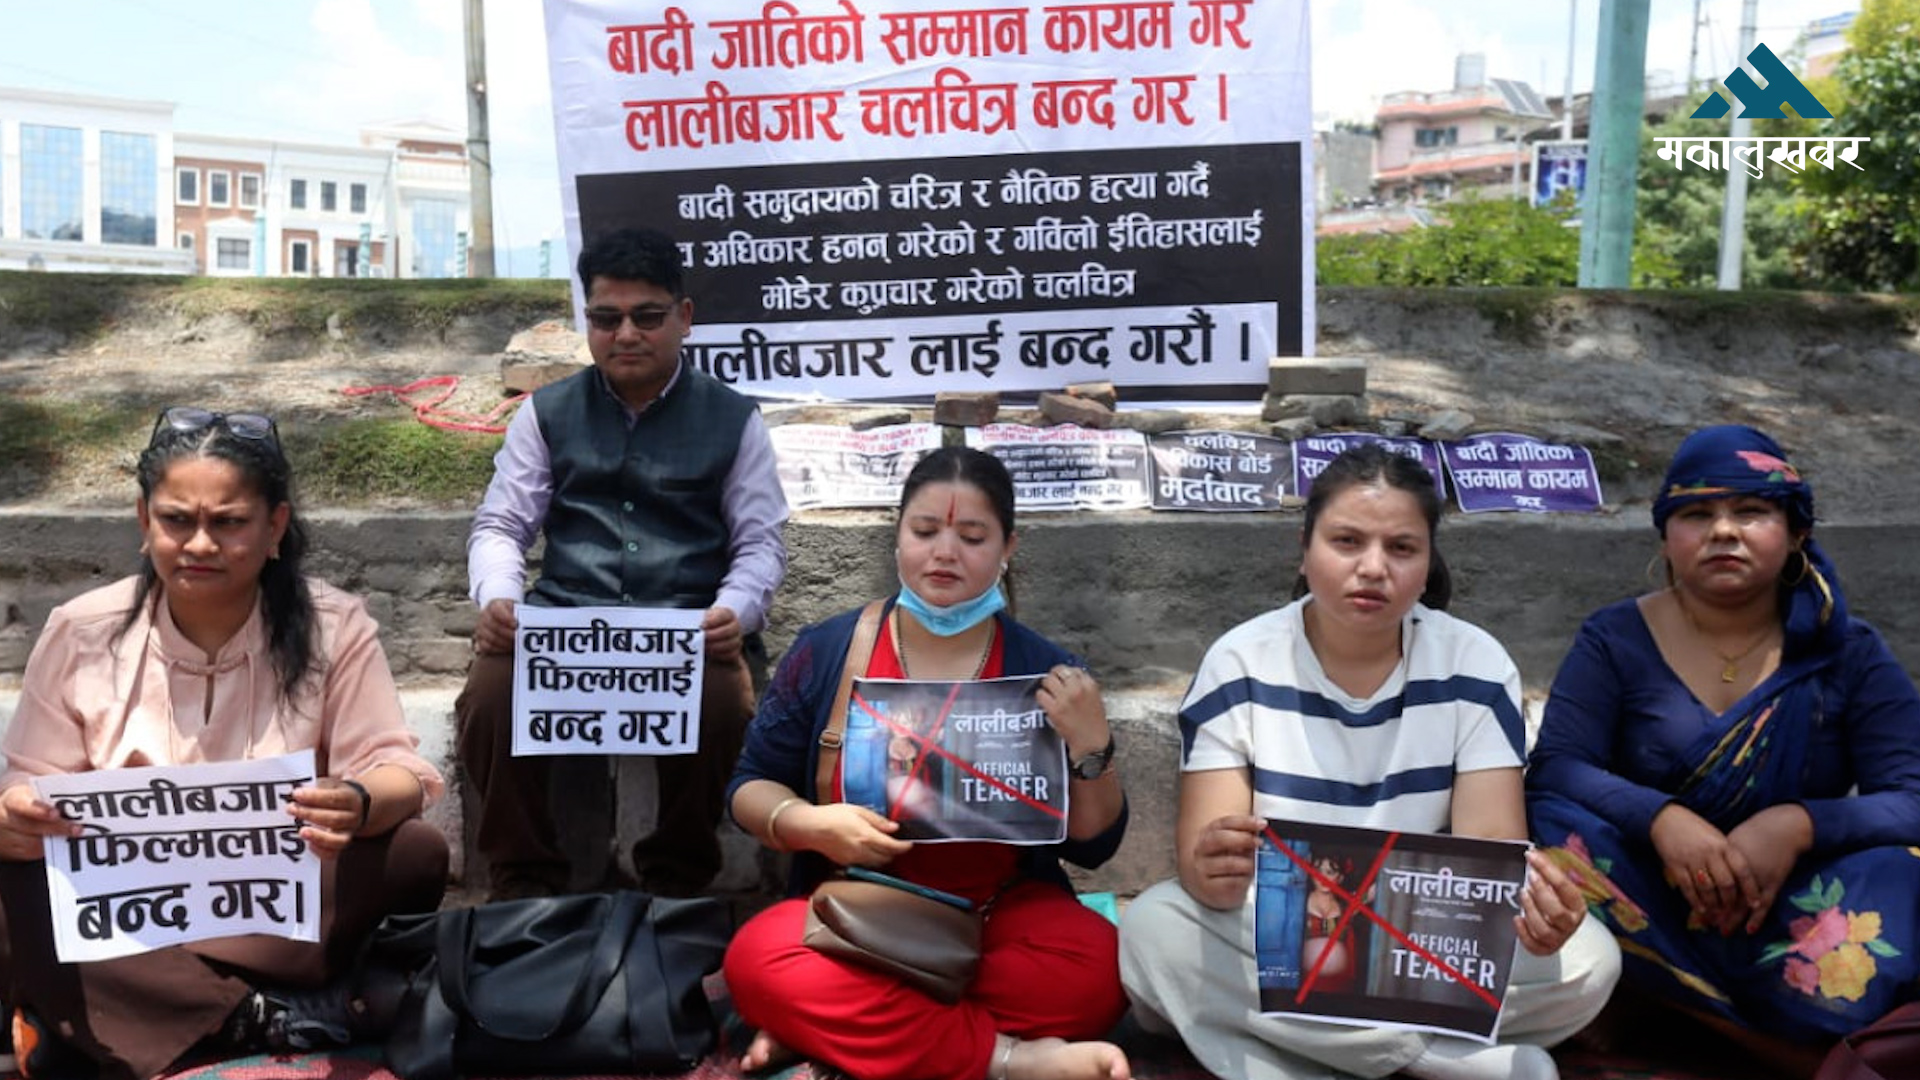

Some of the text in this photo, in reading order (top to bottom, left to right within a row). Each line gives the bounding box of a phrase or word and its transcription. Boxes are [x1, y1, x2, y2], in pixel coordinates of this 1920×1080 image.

[606, 0, 1255, 76] बादी जातिको सम्मान कायम गर
[622, 80, 845, 152] लालीबजार
[859, 66, 1018, 138] चलचित्र
[1032, 78, 1117, 130] बन्द
[1132, 75, 1197, 126] गर
[678, 160, 1211, 223] बादी समुदायको चरित्र र नैतिक हत्या गर्दै
[702, 230, 813, 268] अधिकार
[821, 232, 892, 264] हनन्
[897, 220, 977, 258] गरेको
[984, 227, 1006, 256] र
[1106, 209, 1264, 253] ईतिहासलाई
[760, 262, 1137, 315] मोडेर कुप्रचार गरेको चलचित्र
[909, 319, 1004, 378] लाई
[1019, 325, 1114, 369] बन्द
[1528, 468, 1589, 489] कायम
[523, 618, 700, 655] लालीबजार
[527, 656, 695, 697] फिल्मलाई
[529, 709, 606, 746] बन्द
[950, 708, 1047, 733] लालीबजा
[960, 775, 1049, 802] TEASER
[972, 761, 1034, 776] OFFICIAL
[66, 817, 311, 873] फिल्मलाई
[1382, 867, 1520, 909] लालीबजार
[76, 883, 191, 941] बन्द
[1407, 932, 1481, 957] OFFICIAL
[1391, 948, 1496, 990] TEASER
